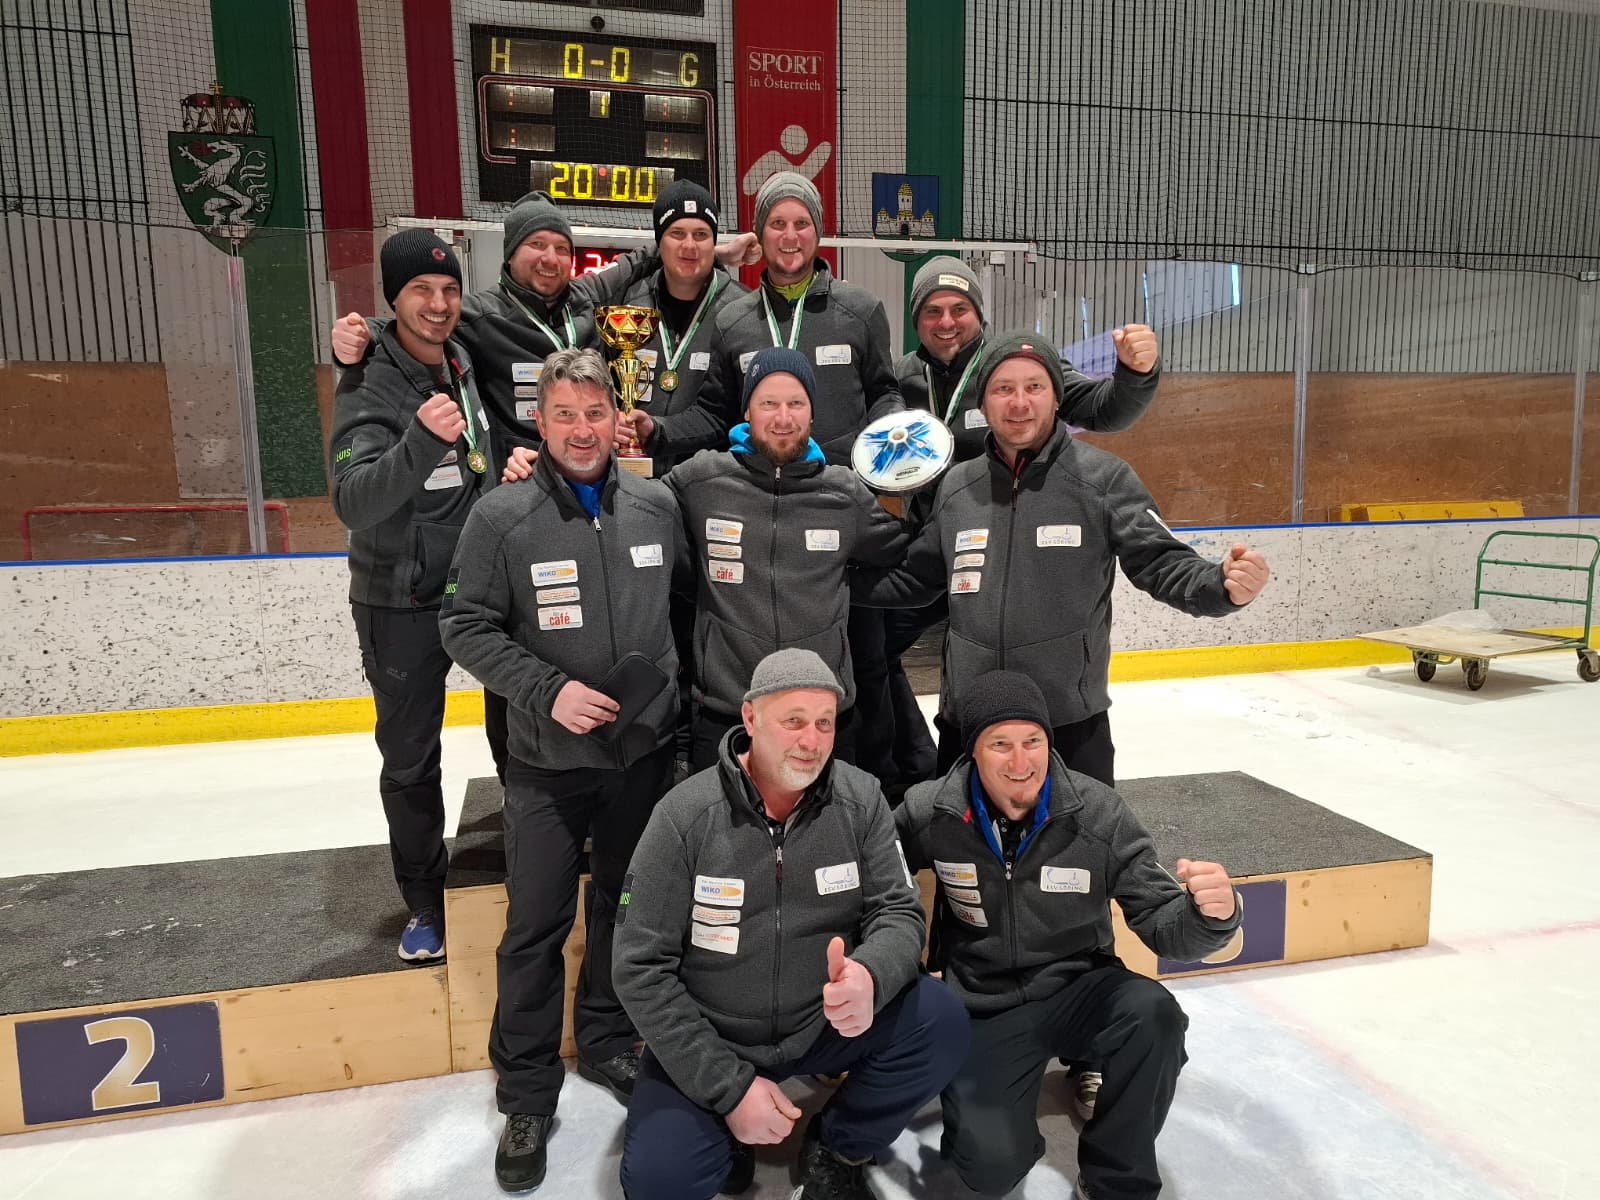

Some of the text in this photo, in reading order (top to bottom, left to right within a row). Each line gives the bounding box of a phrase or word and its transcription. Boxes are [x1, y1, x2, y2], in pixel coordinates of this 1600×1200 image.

[491, 37, 511, 73] H
[680, 52, 699, 88] G
[748, 51, 822, 75] SPORT
[749, 73, 821, 91] in Österreich
[716, 568, 734, 580] café
[549, 612, 570, 626] café
[701, 885, 721, 894] WIKO
[83, 1016, 161, 1111] 2
